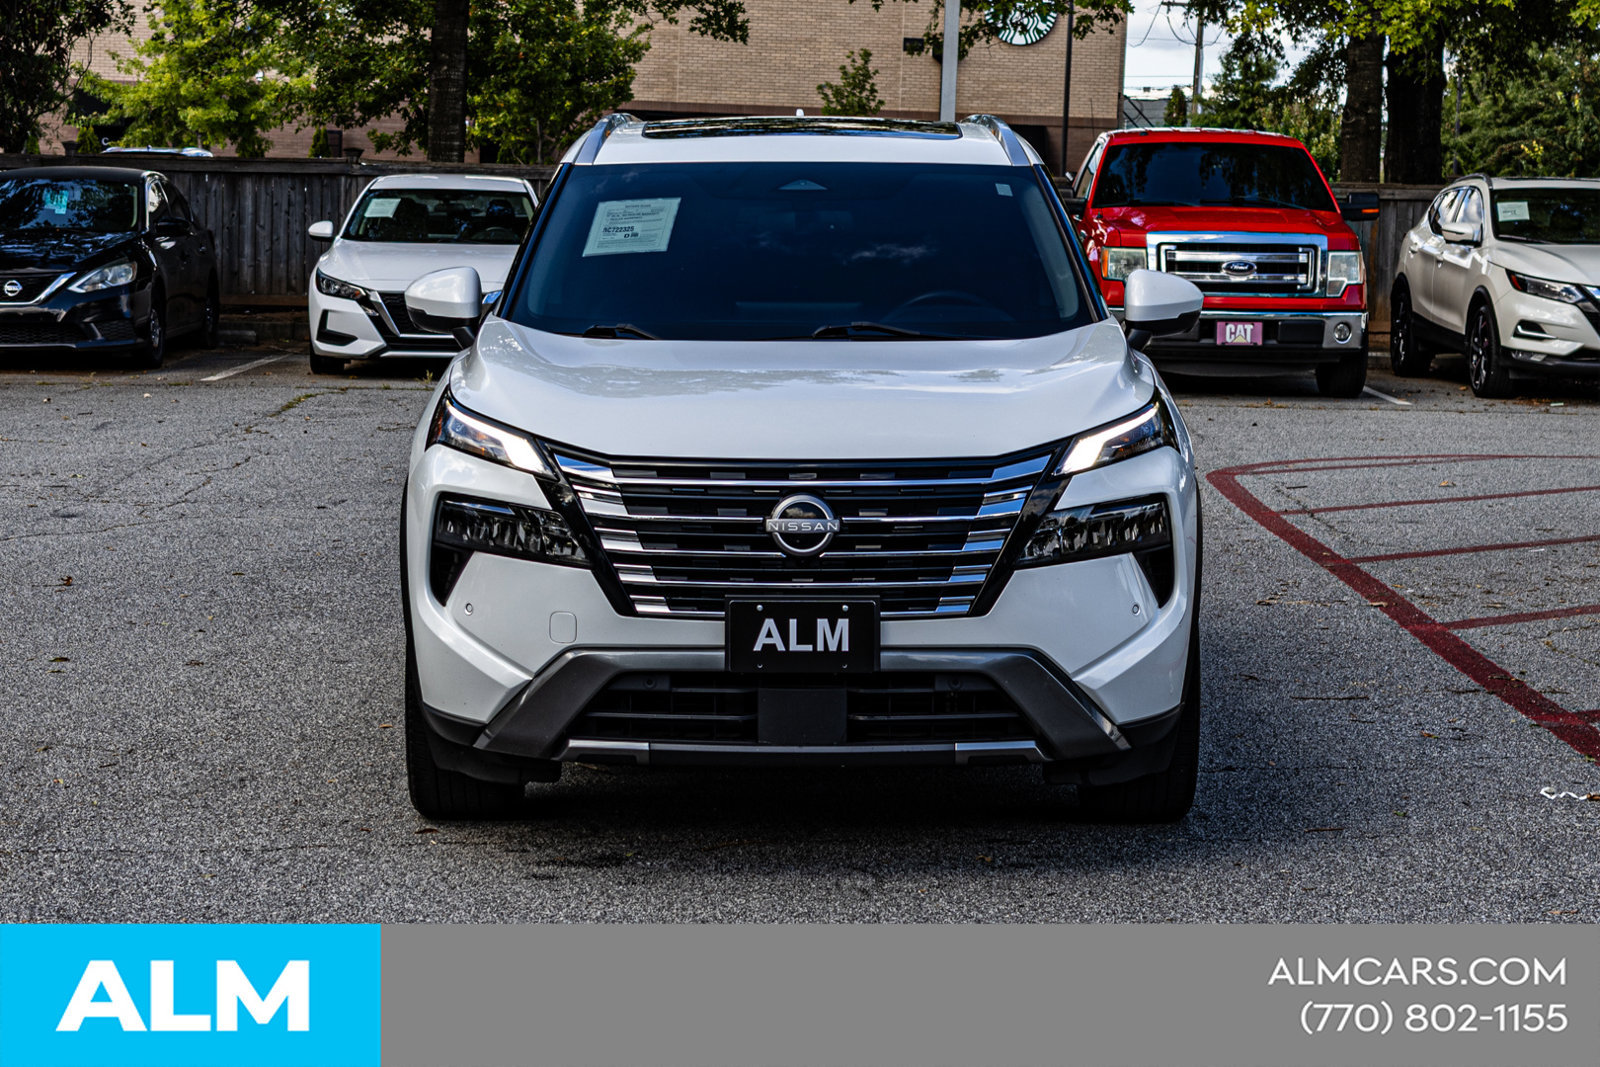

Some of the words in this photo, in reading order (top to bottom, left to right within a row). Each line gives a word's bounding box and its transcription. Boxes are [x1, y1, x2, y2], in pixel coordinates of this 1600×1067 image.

[1225, 322, 1254, 343] CAT
[767, 521, 839, 531] NISSAN
[753, 618, 850, 652] ALM
